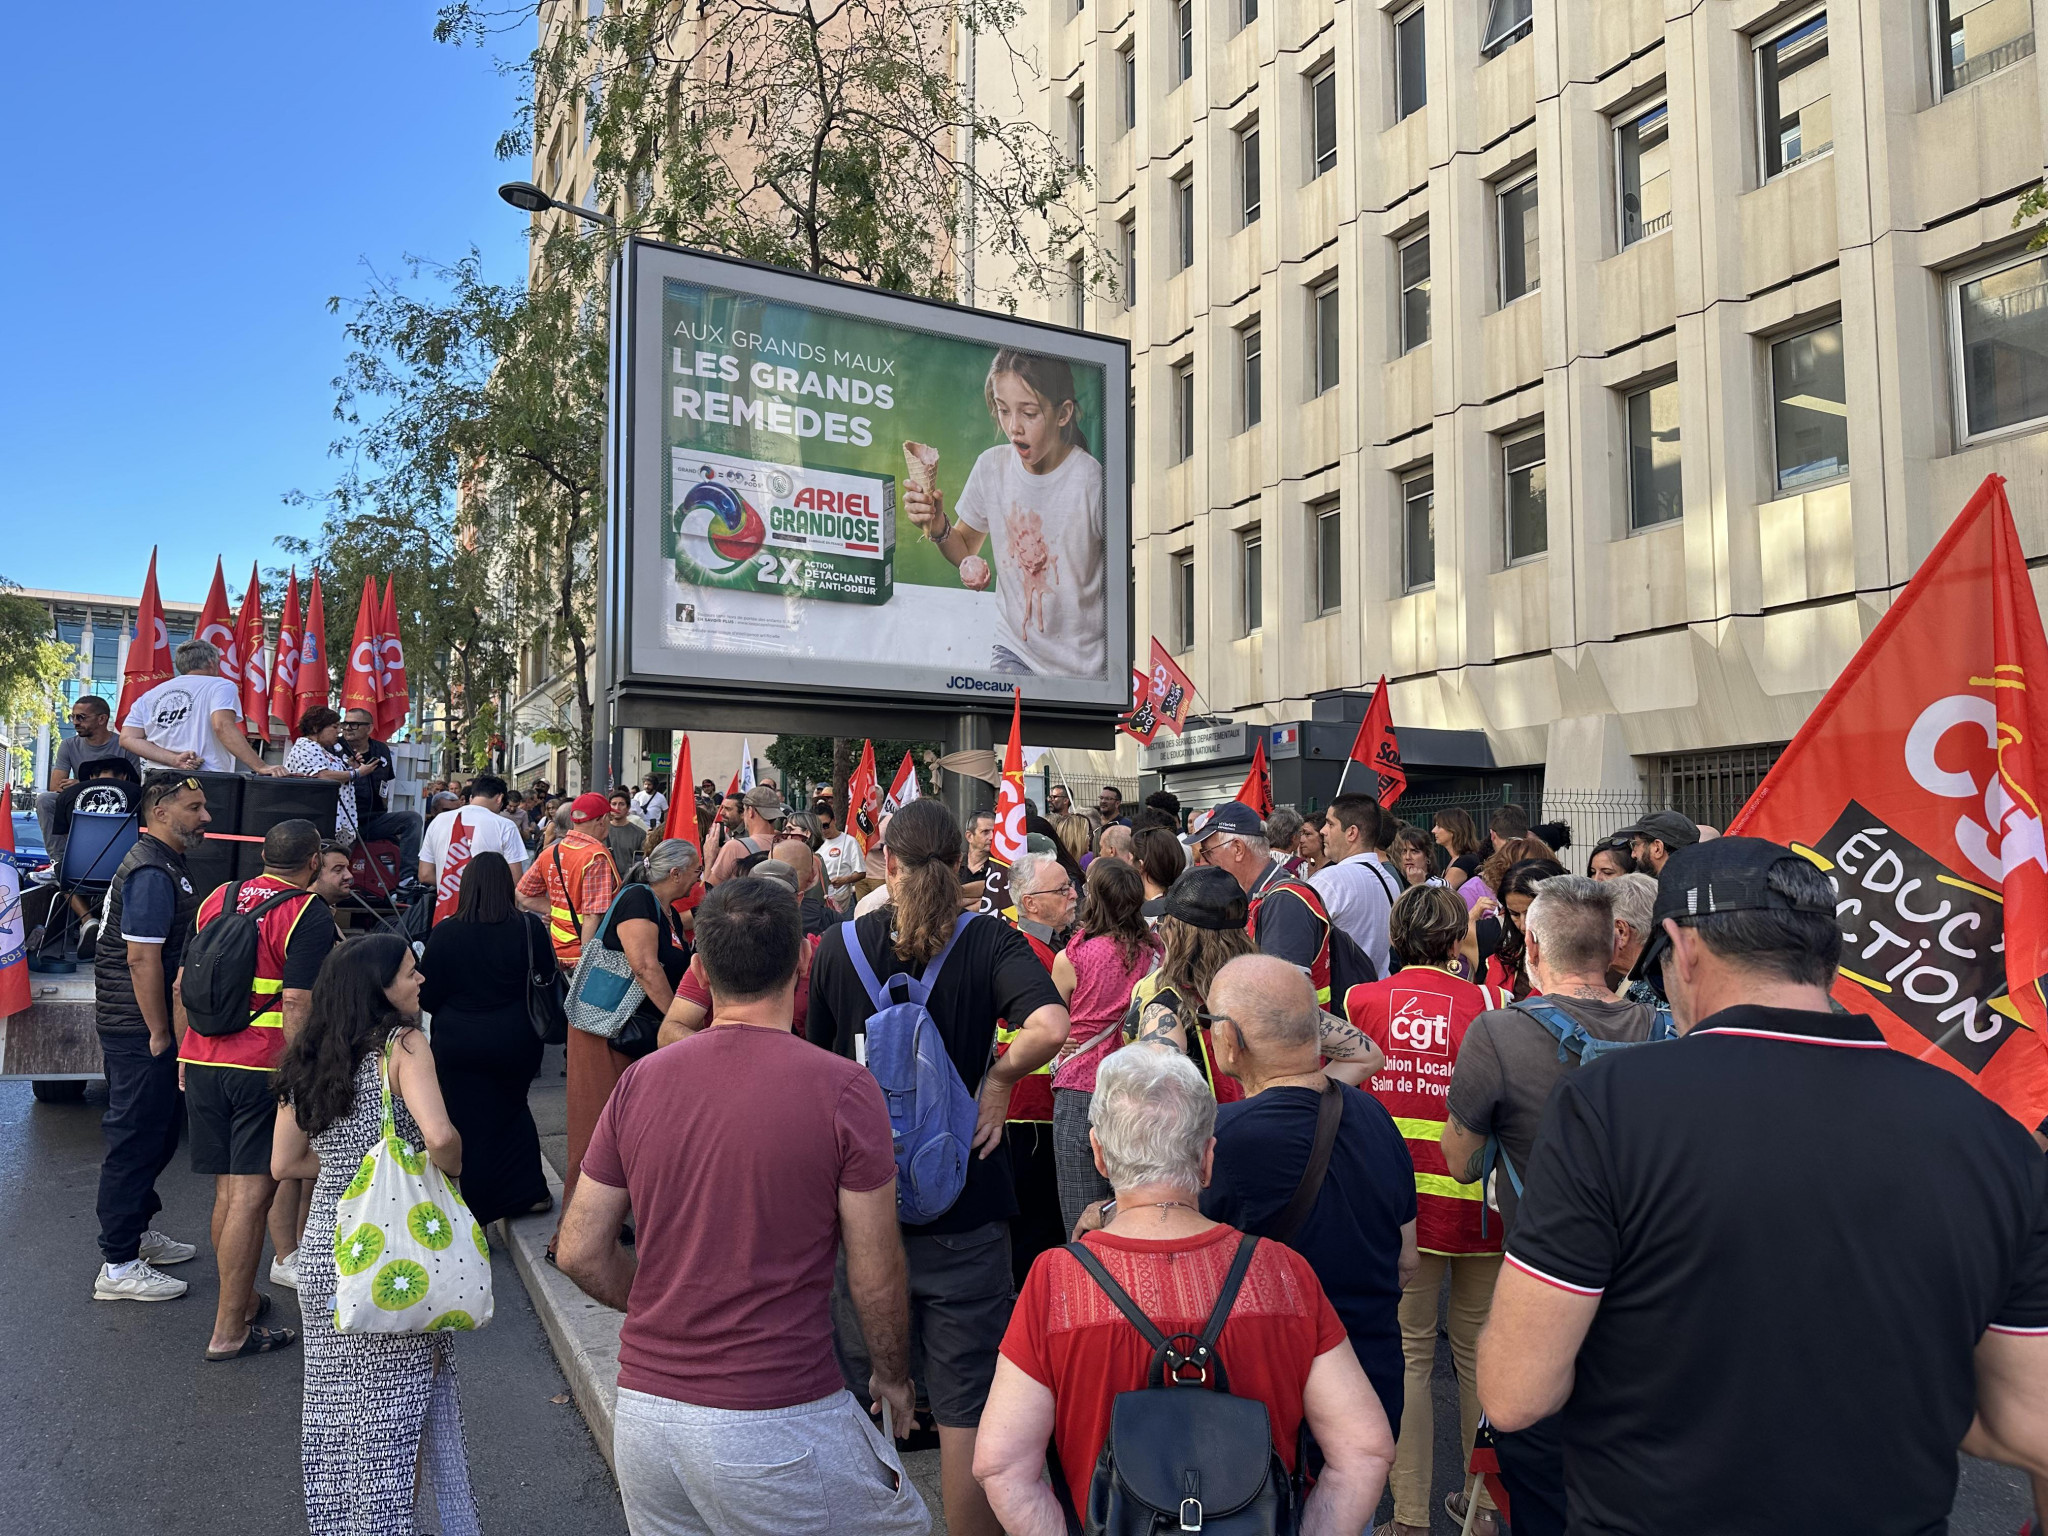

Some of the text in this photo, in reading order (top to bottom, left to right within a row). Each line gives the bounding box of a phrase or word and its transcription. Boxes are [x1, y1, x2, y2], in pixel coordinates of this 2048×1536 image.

[674, 320, 895, 377] AUX GRANDS MAUX
[672, 347, 895, 410] LES GRANDS
[673, 386, 873, 447] REMÈDES
[793, 487, 879, 518] ARIEL
[769, 506, 879, 543] GRANDIOSE
[757, 554, 801, 587] 2X
[804, 560, 834, 571] ACTION
[804, 567, 876, 586] DÉTACHANTE
[804, 579, 816, 588] ET
[946, 676, 1014, 692] JCDecaux
[1160, 752, 1167, 760] DE
[1195, 744, 1221, 755] NATIONALE
[1166, 739, 1174, 749] DES
[1175, 736, 1196, 747] SERVICES
[1391, 1014, 1448, 1051] cgt
[1397, 1076, 1413, 1093] de
